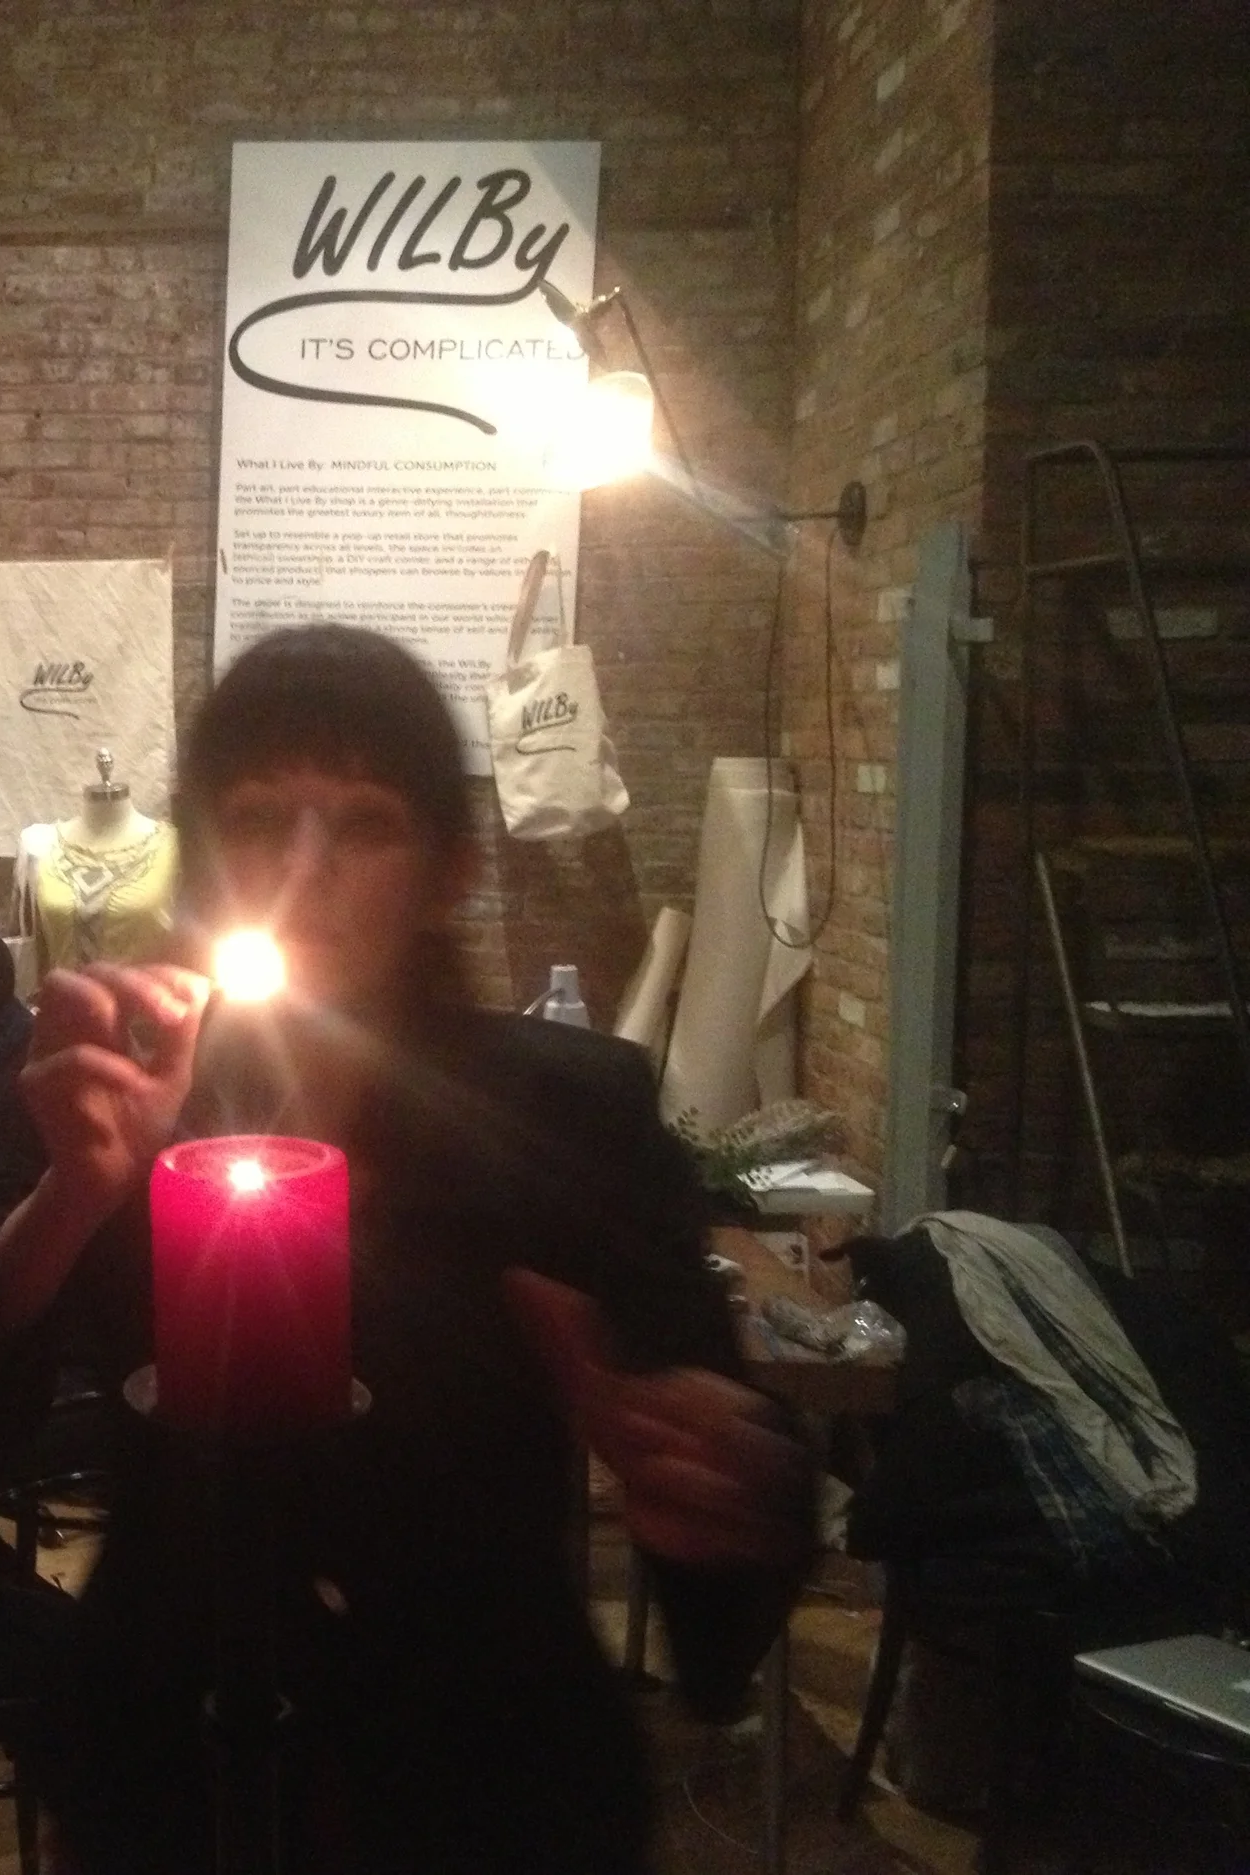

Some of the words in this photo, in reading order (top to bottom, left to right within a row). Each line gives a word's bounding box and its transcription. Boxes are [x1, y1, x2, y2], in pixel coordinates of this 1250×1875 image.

[293, 168, 570, 290] WILBy
[300, 337, 355, 361] IT'S
[237, 459, 269, 471] What
[280, 459, 305, 471] Live
[330, 459, 390, 472] MINDFUL
[393, 459, 498, 472] CONSUMPTION
[278, 484, 301, 495] part
[302, 484, 365, 494] educational
[255, 495, 282, 505] What
[291, 496, 311, 505] Live
[315, 496, 327, 507] By
[268, 530, 282, 540] to
